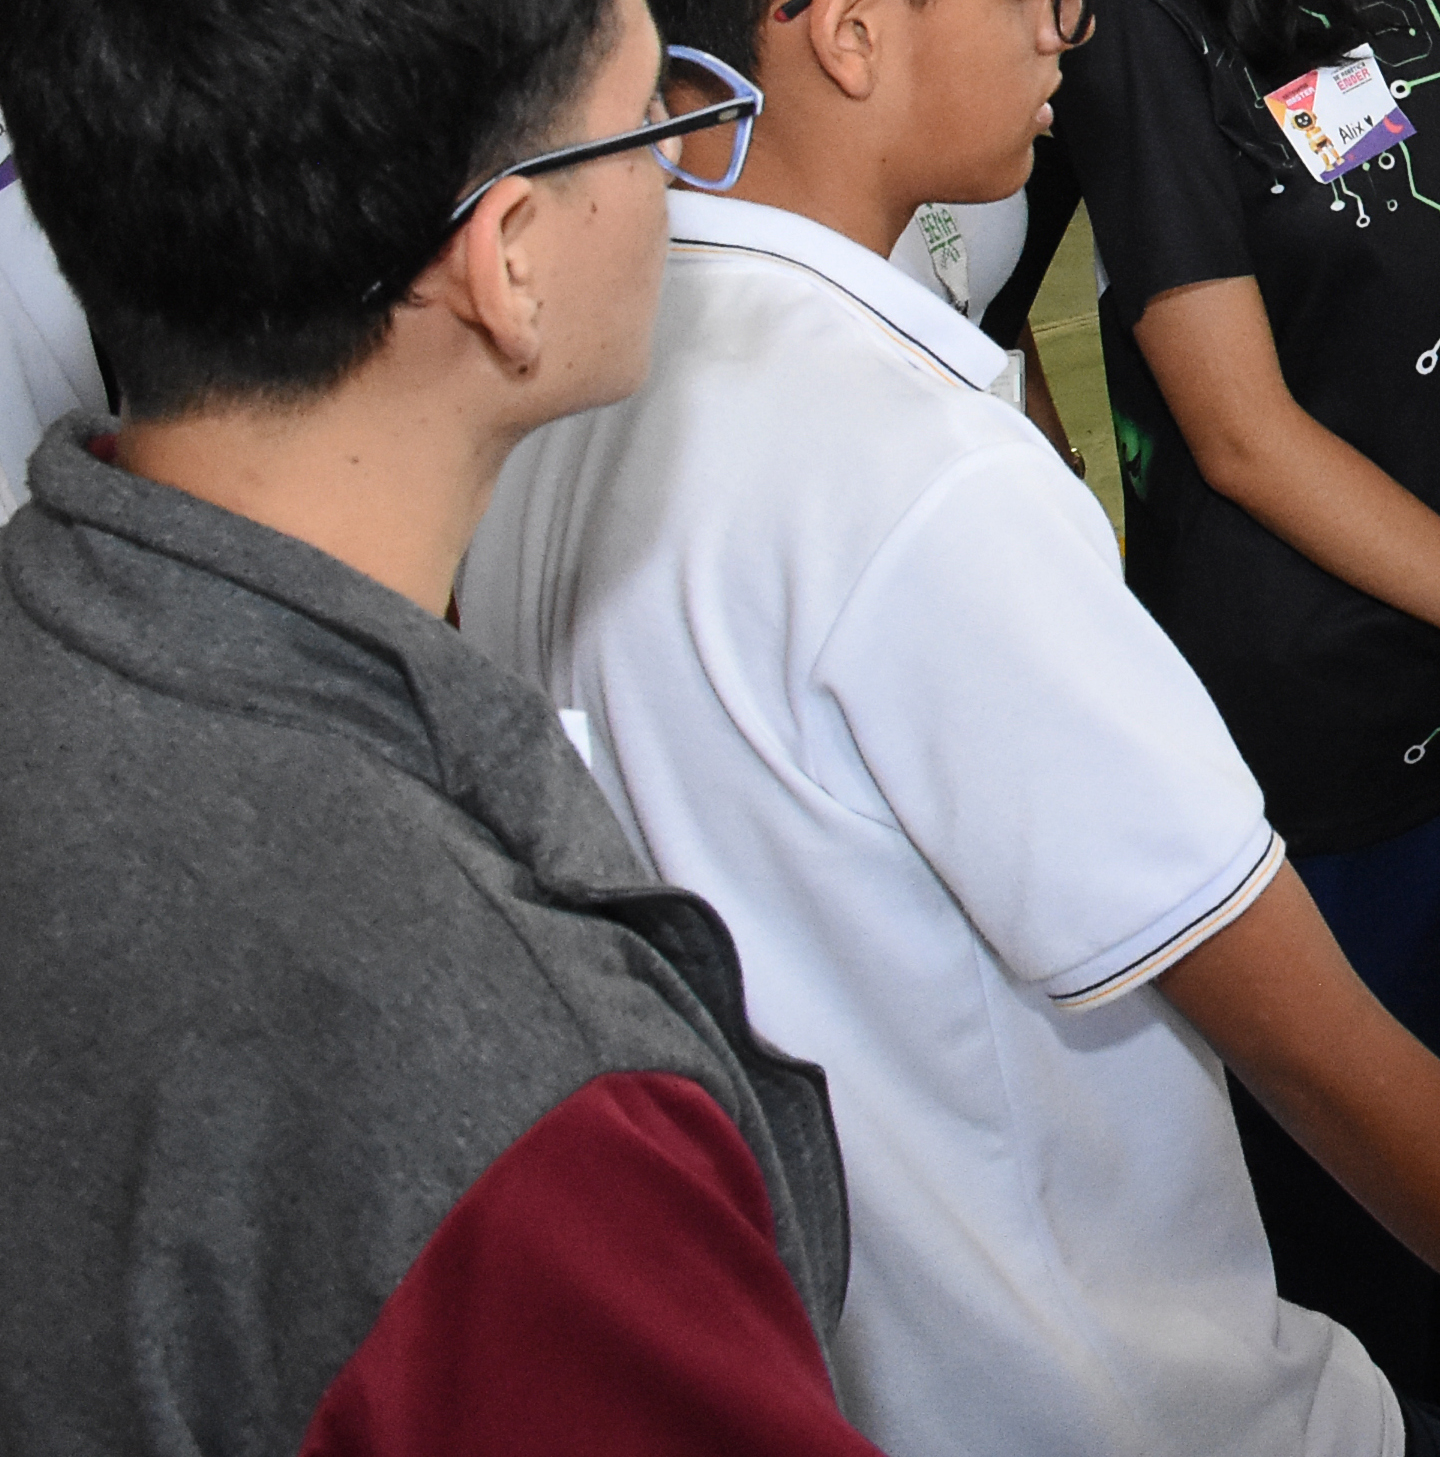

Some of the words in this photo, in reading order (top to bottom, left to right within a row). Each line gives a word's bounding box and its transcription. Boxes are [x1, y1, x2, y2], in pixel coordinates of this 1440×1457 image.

[1336, 68, 1371, 91] ENDER
[1339, 121, 1364, 144] Alix
[920, 208, 958, 244] SENA
